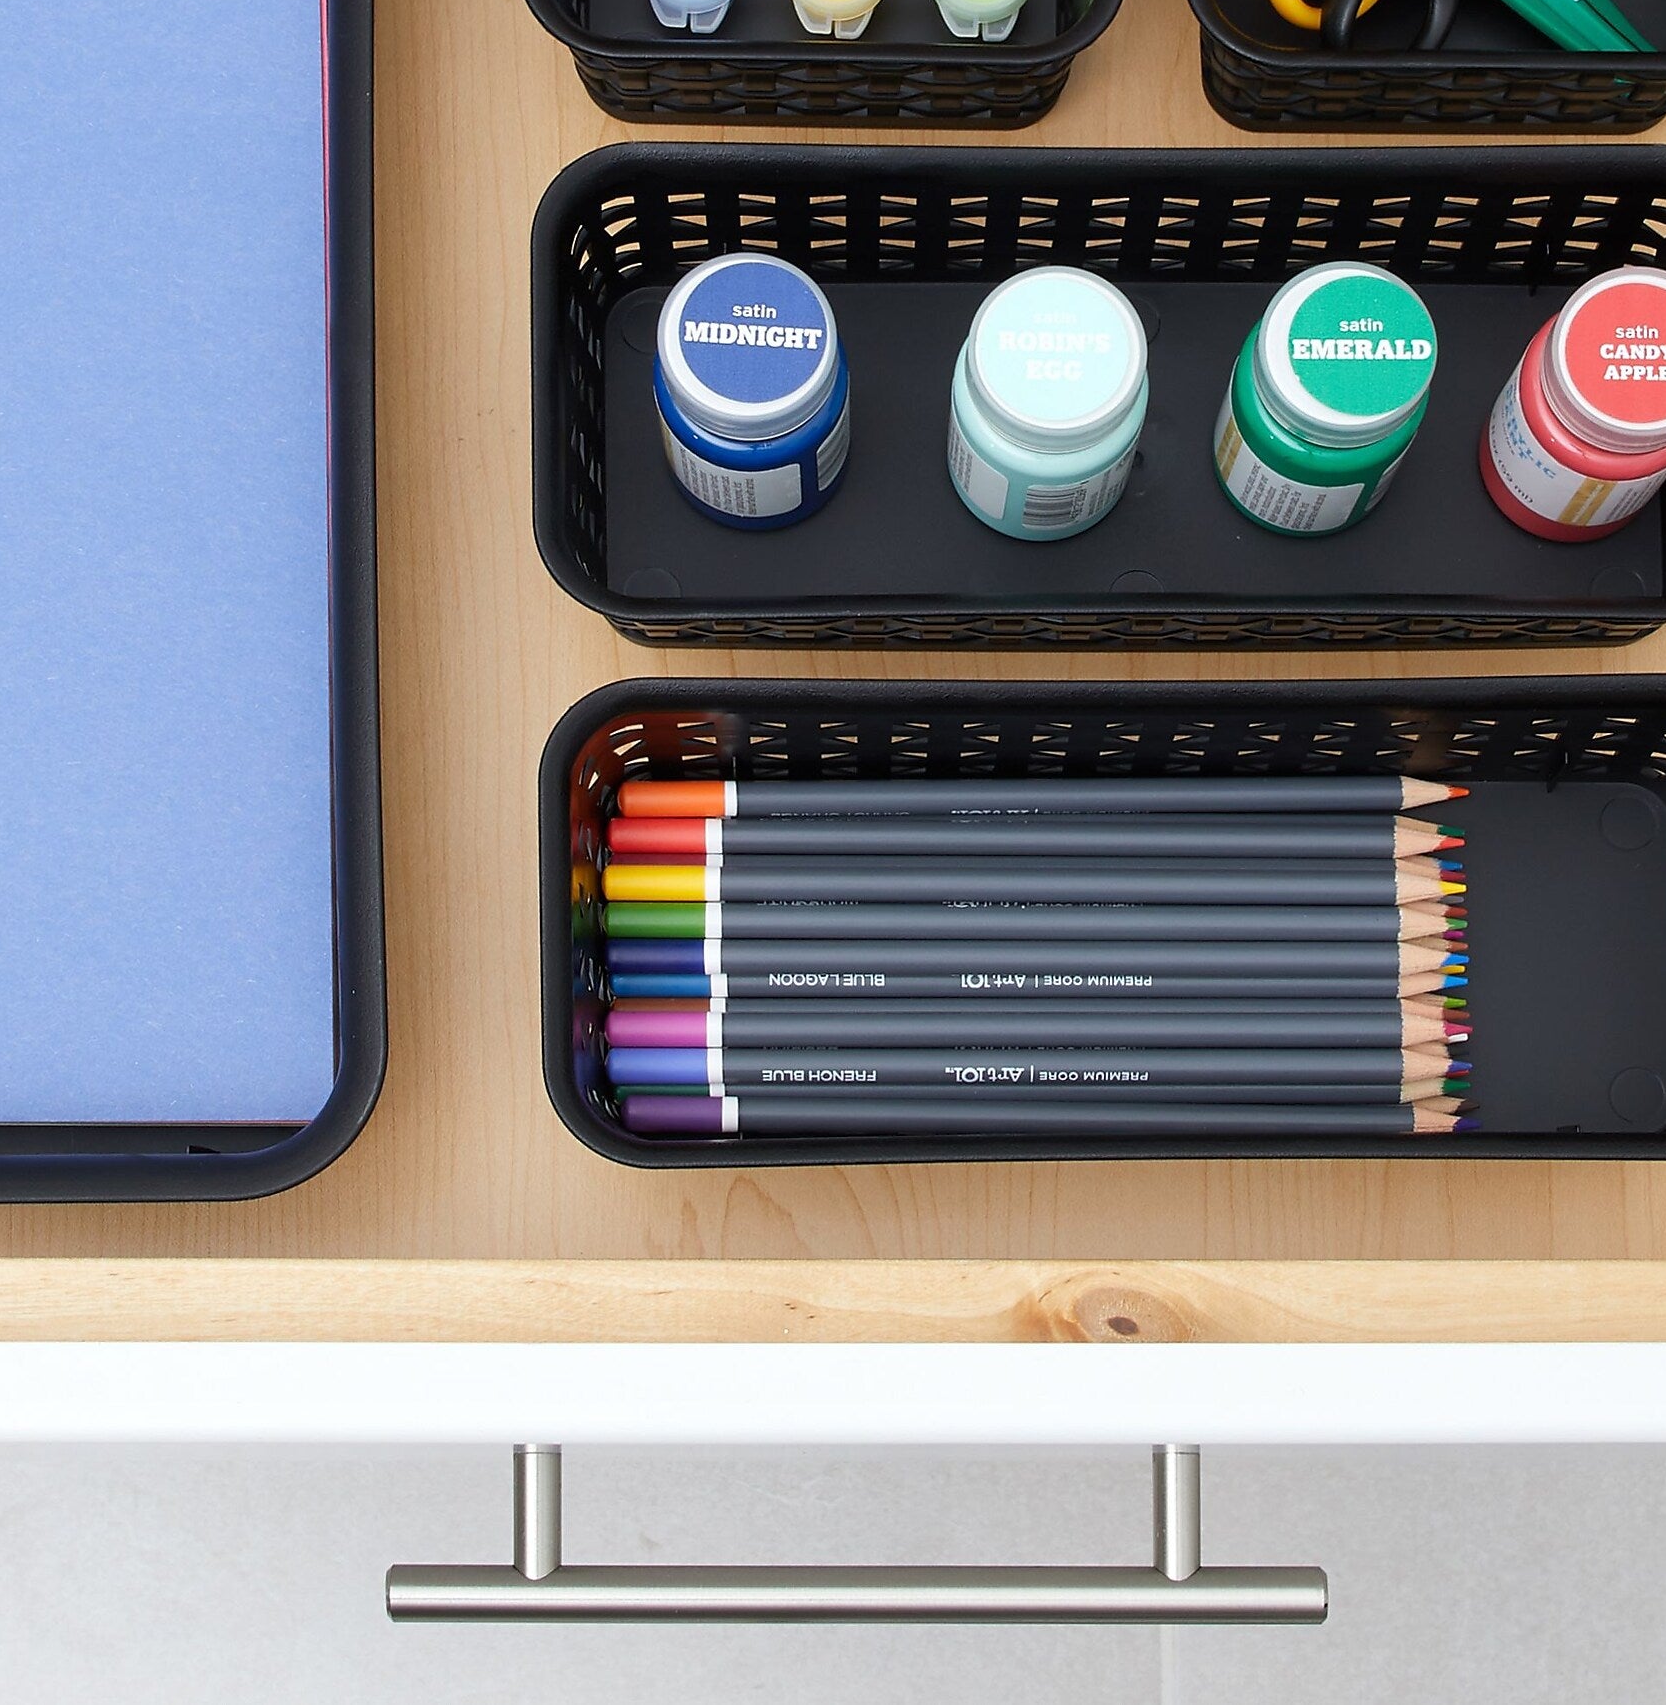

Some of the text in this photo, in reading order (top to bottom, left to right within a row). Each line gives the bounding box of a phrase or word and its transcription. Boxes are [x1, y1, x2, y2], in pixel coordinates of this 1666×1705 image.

[731, 302, 777, 320] satin
[1338, 316, 1384, 333] satin
[683, 321, 823, 351] MIDNIGHT
[1615, 324, 1660, 340] satin
[1291, 338, 1433, 362] EMERALD
[768, 974, 841, 987] LAGOON
[843, 974, 885, 987] BLUE
[1044, 976, 1083, 986] CORE
[1088, 975, 1153, 987] PREMIUM
[762, 1069, 804, 1082] BLUE
[808, 1069, 877, 1082] FRENCH
[1039, 1071, 1078, 1081] CORE
[1083, 1071, 1149, 1082] PREMIUM
